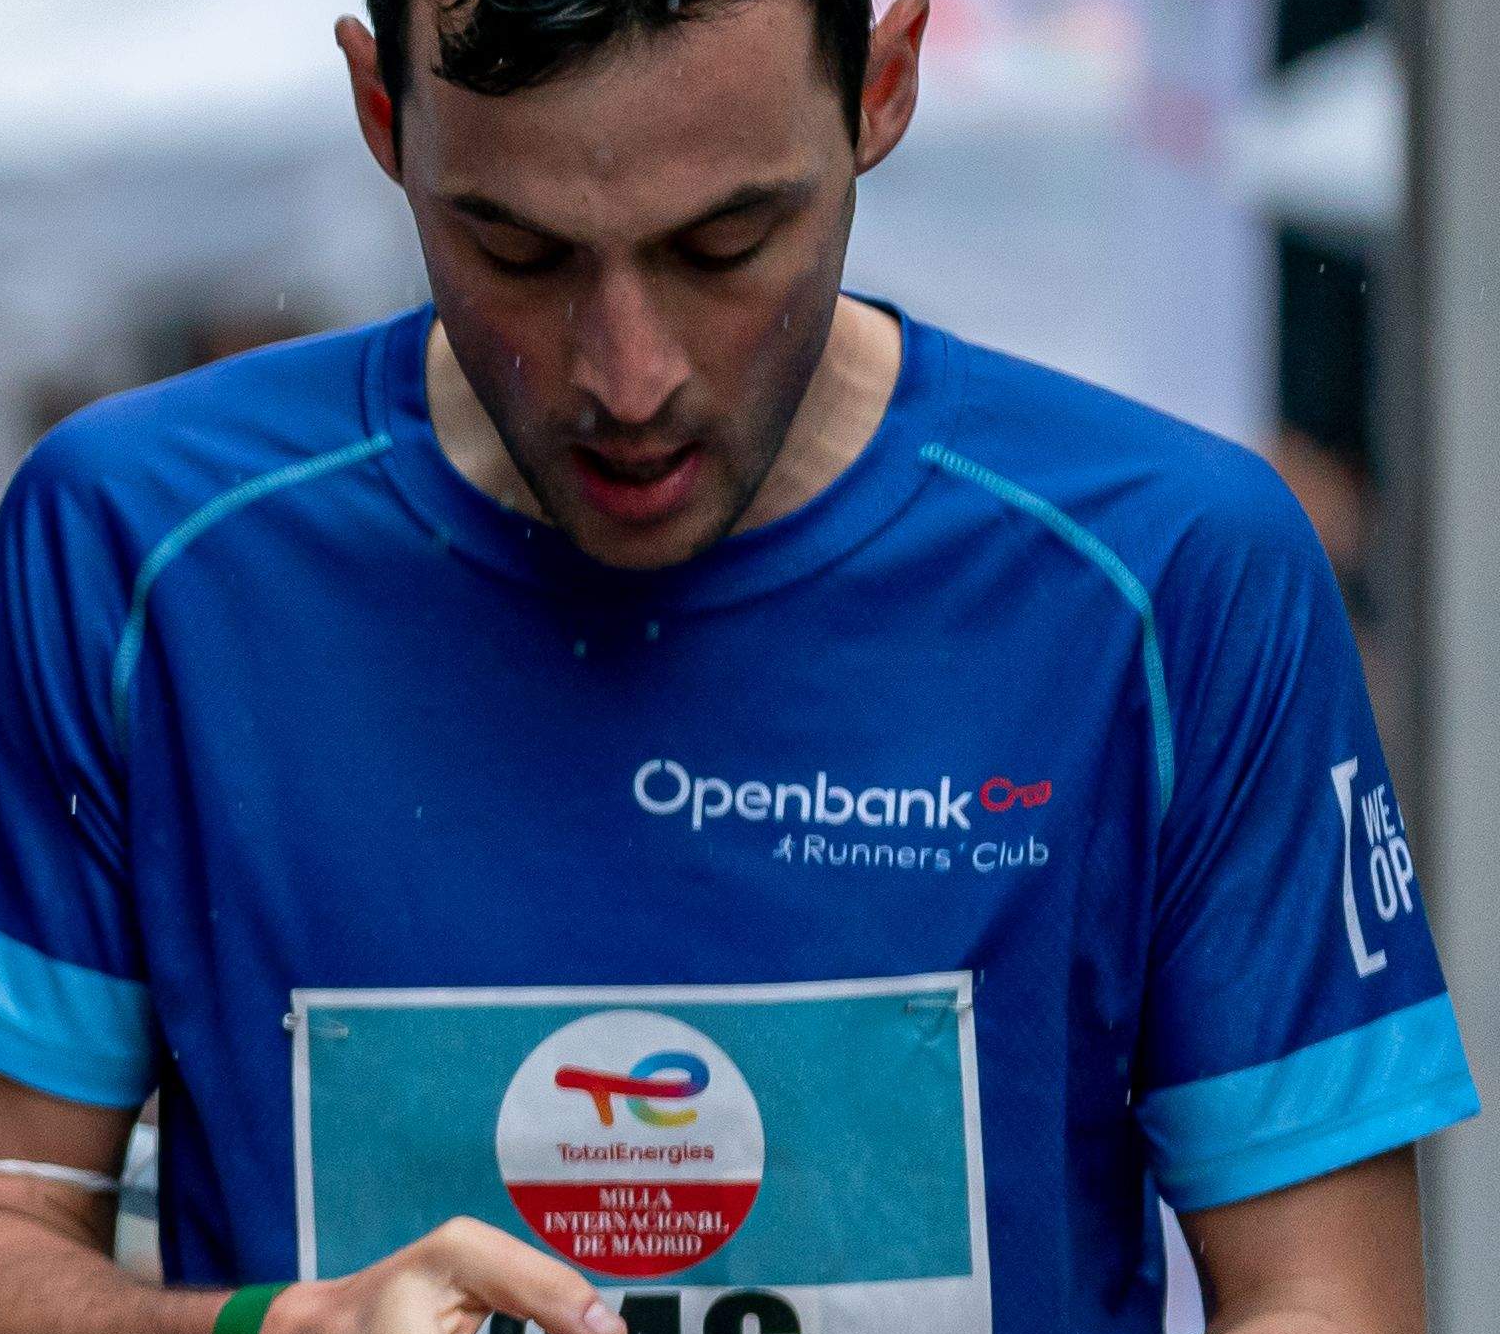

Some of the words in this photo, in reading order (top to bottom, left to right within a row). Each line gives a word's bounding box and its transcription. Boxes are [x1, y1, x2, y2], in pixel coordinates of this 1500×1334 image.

[633, 758, 973, 831] Openbank
[972, 835, 1050, 873] Club
[557, 1140, 715, 1166] TotalEnergies
[600, 1188, 672, 1210] MILLA
[573, 1234, 606, 1257] DE
[611, 1234, 702, 1257] MADRID
